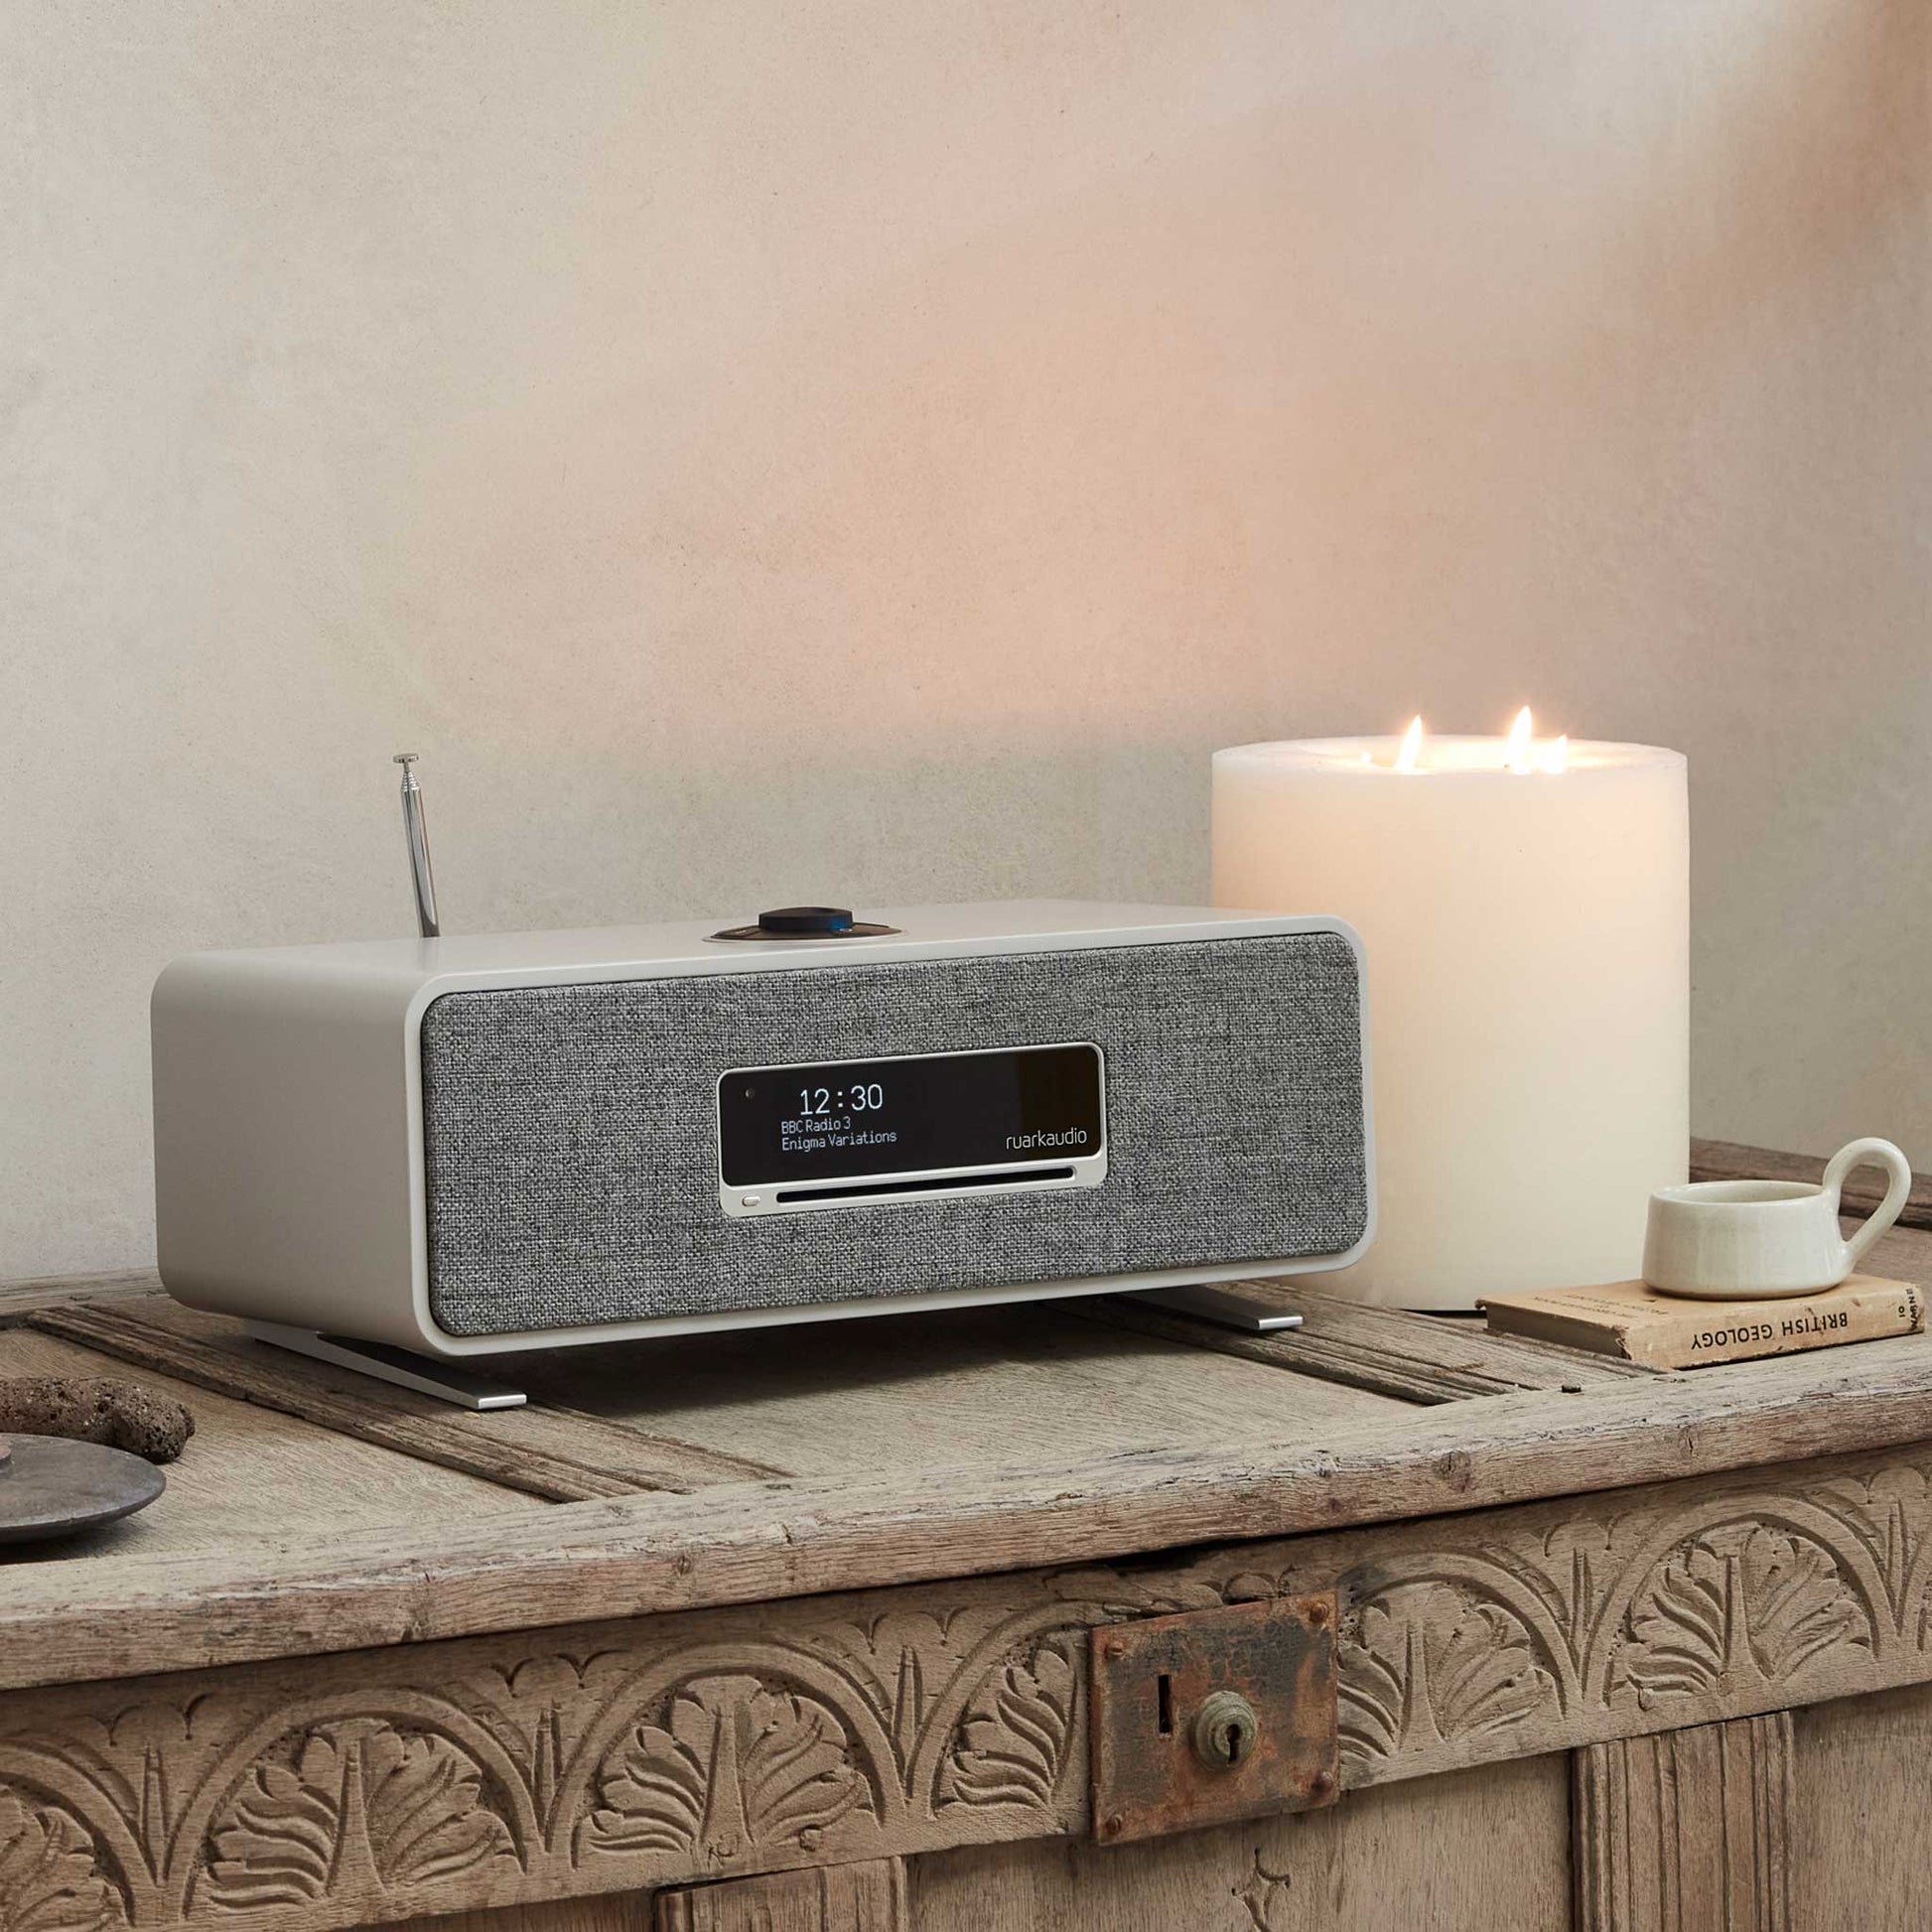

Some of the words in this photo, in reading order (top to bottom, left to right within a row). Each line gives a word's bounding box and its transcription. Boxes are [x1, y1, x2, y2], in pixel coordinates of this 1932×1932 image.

[800, 1083, 883, 1115] 12:30
[781, 1120, 803, 1134] BBC
[805, 1118, 841, 1132] Radio
[843, 1115, 852, 1130] 3
[781, 1137, 826, 1152] Enigma
[827, 1130, 897, 1147] Variations
[1006, 1127, 1087, 1150] ruarkaudio
[1781, 1311, 1848, 1336] BRITISH
[1690, 1323, 1773, 1350] GEOLOGY
